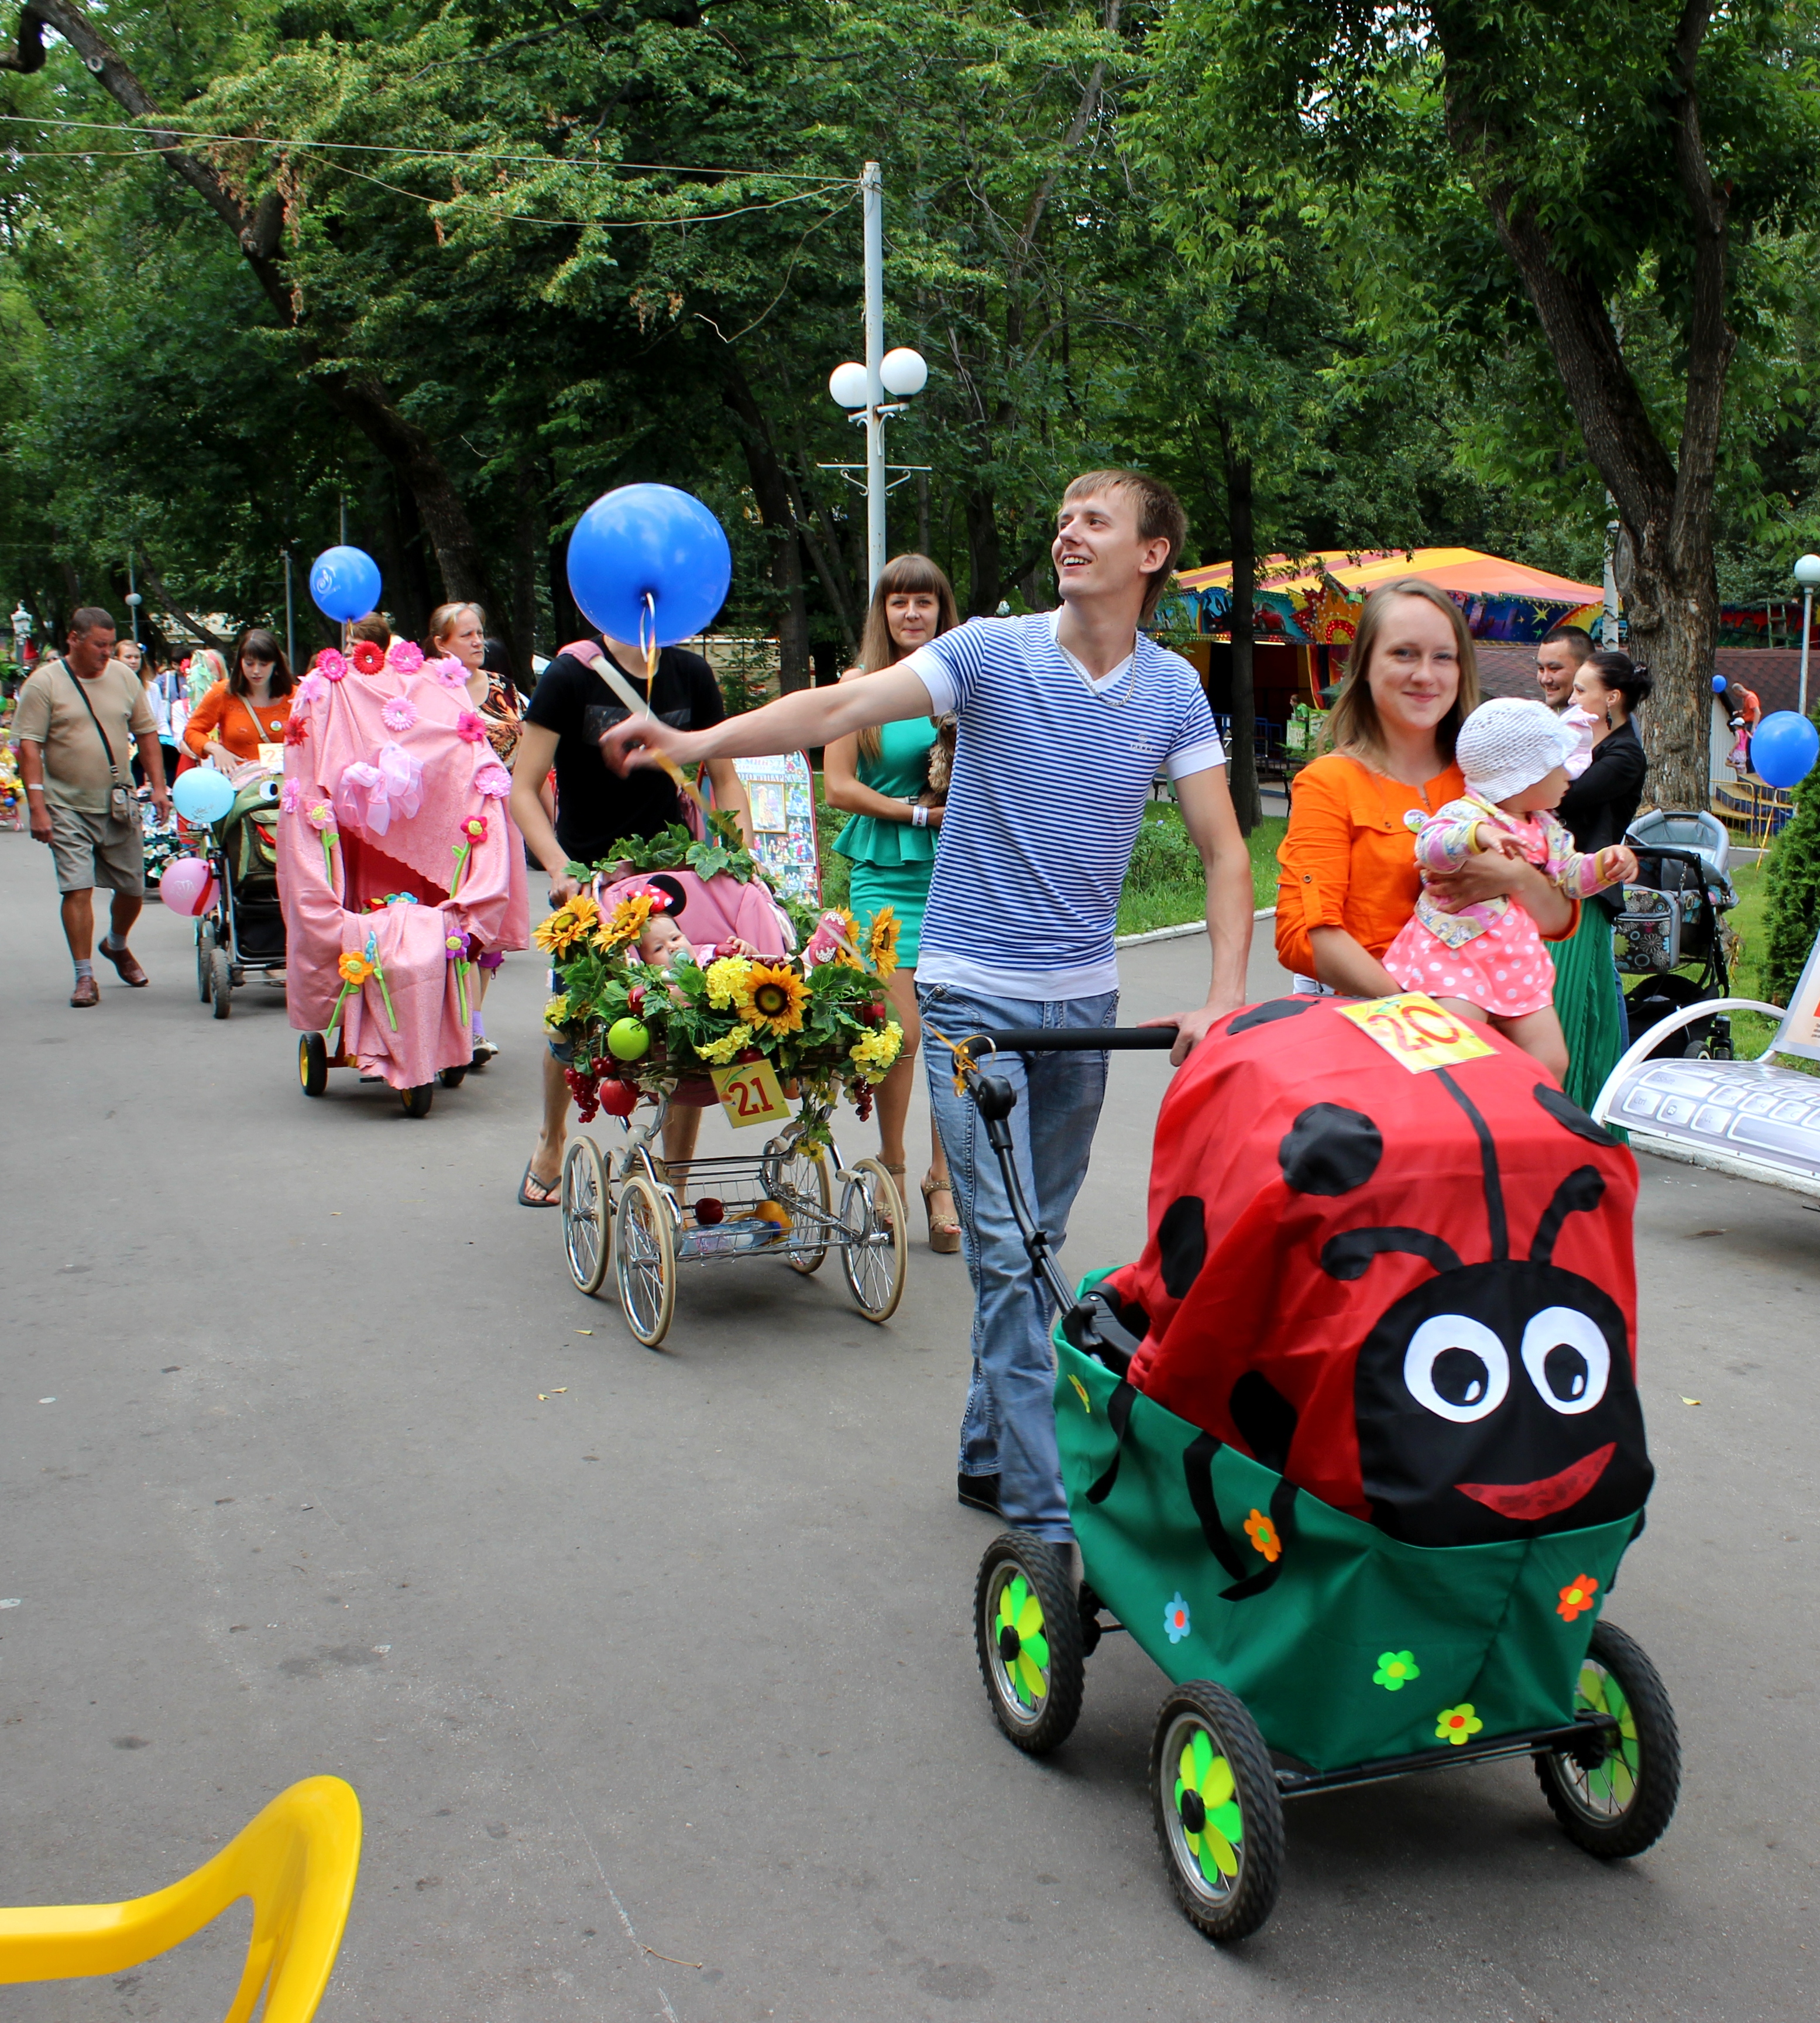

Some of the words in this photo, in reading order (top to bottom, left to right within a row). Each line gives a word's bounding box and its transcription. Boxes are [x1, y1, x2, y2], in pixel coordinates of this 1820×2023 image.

[737, 772, 754, 780] ОТО
[765, 773, 795, 783] ПАРКА
[1367, 1005, 1460, 1052] 20
[728, 1076, 774, 1117] 21
[1633, 1095, 1647, 1106] Ctrl
